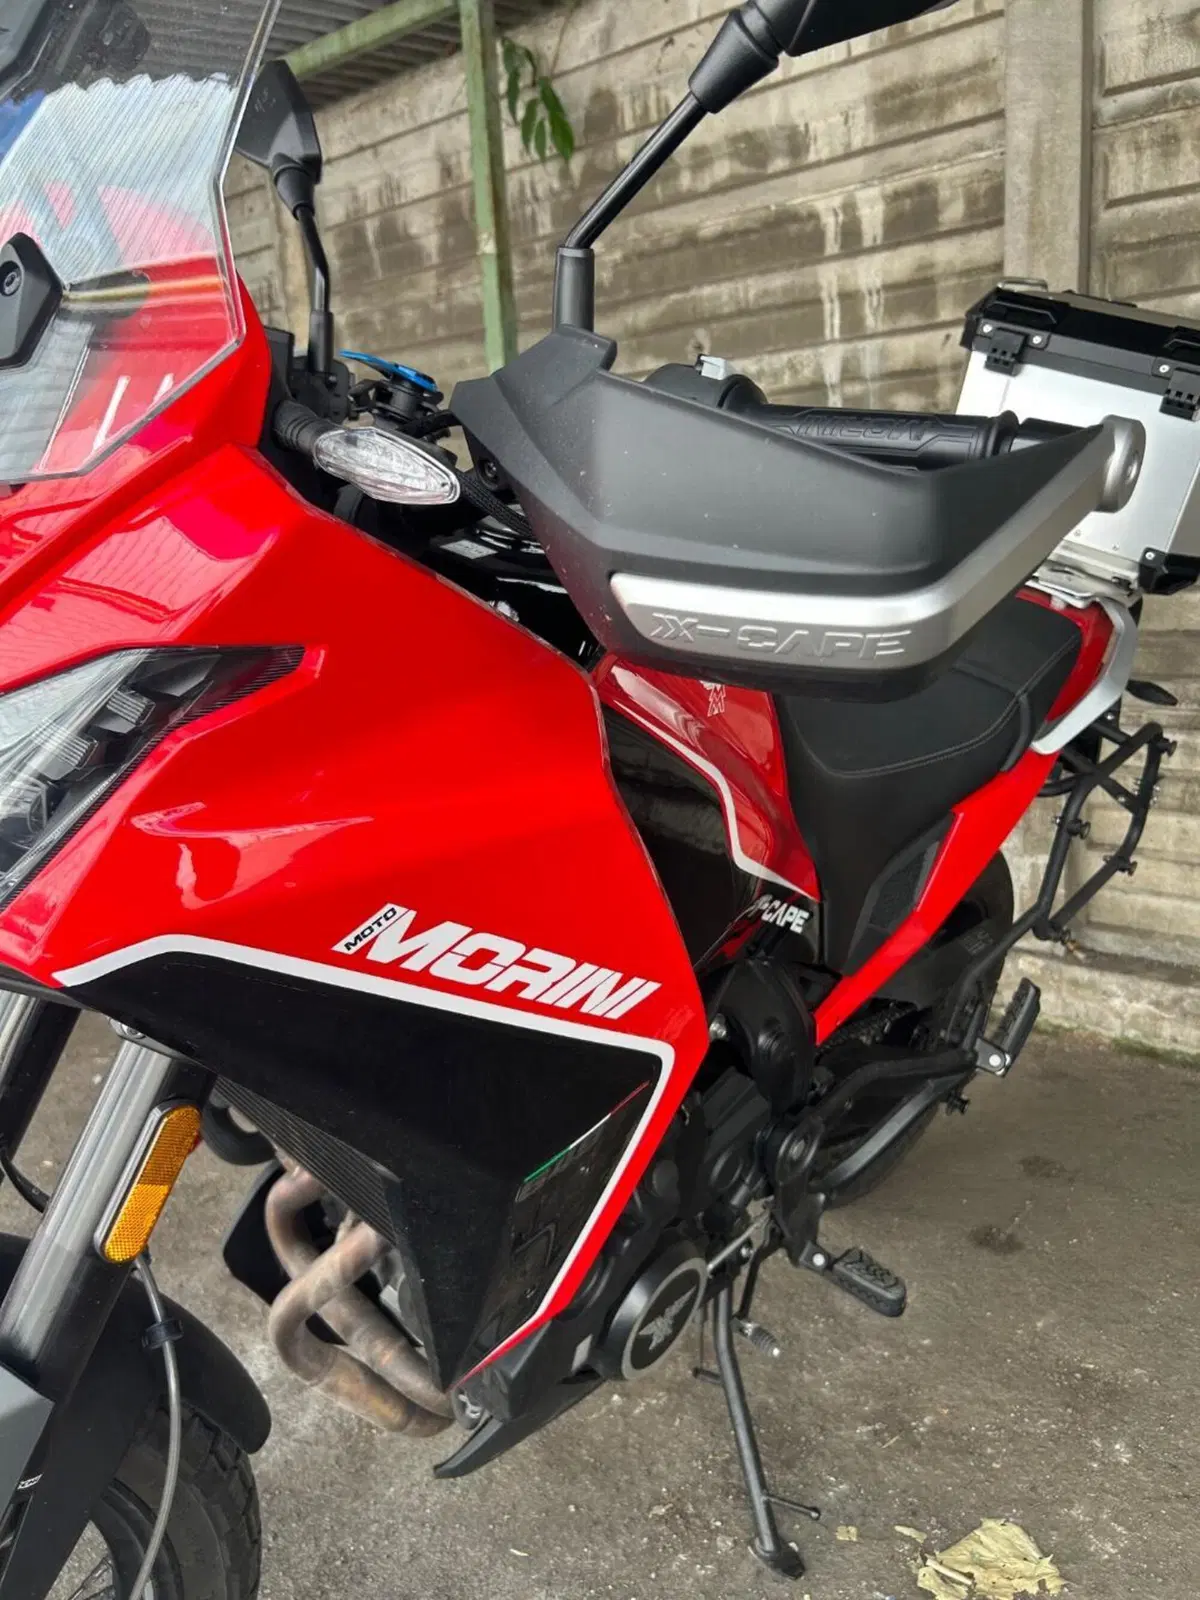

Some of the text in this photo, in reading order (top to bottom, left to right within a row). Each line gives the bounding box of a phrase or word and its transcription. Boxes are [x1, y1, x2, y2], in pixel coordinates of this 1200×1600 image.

[650, 612, 911, 659] X-CAPE
[344, 907, 662, 1020] MOTO MORINI
